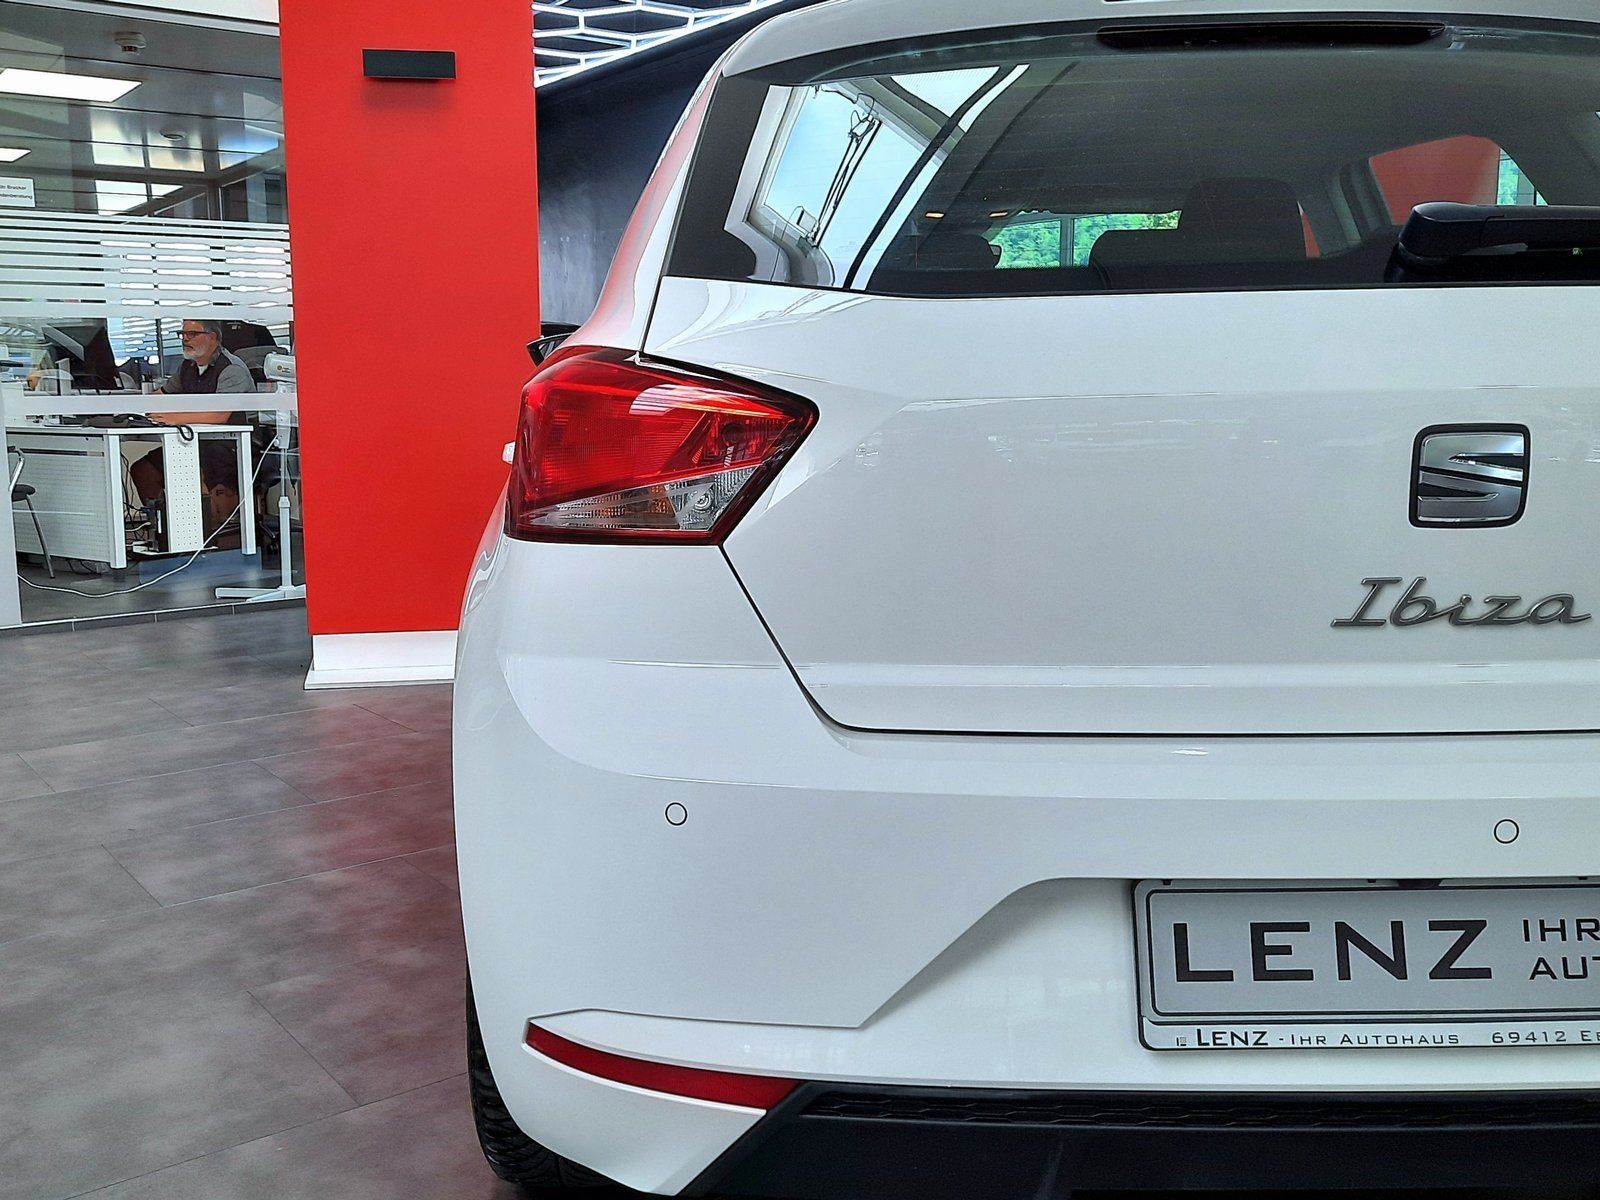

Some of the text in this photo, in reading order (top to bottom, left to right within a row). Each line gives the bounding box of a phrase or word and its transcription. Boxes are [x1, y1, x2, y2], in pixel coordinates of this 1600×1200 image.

[1330, 576, 1592, 627] Ibiza
[1522, 918, 1600, 942] IHR
[1173, 920, 1492, 982] LENZ
[1196, 1028, 1268, 1047] LENZ
[1340, 1033, 1460, 1046] AUTOHAUS
[1491, 1031, 1567, 1044] 69412
